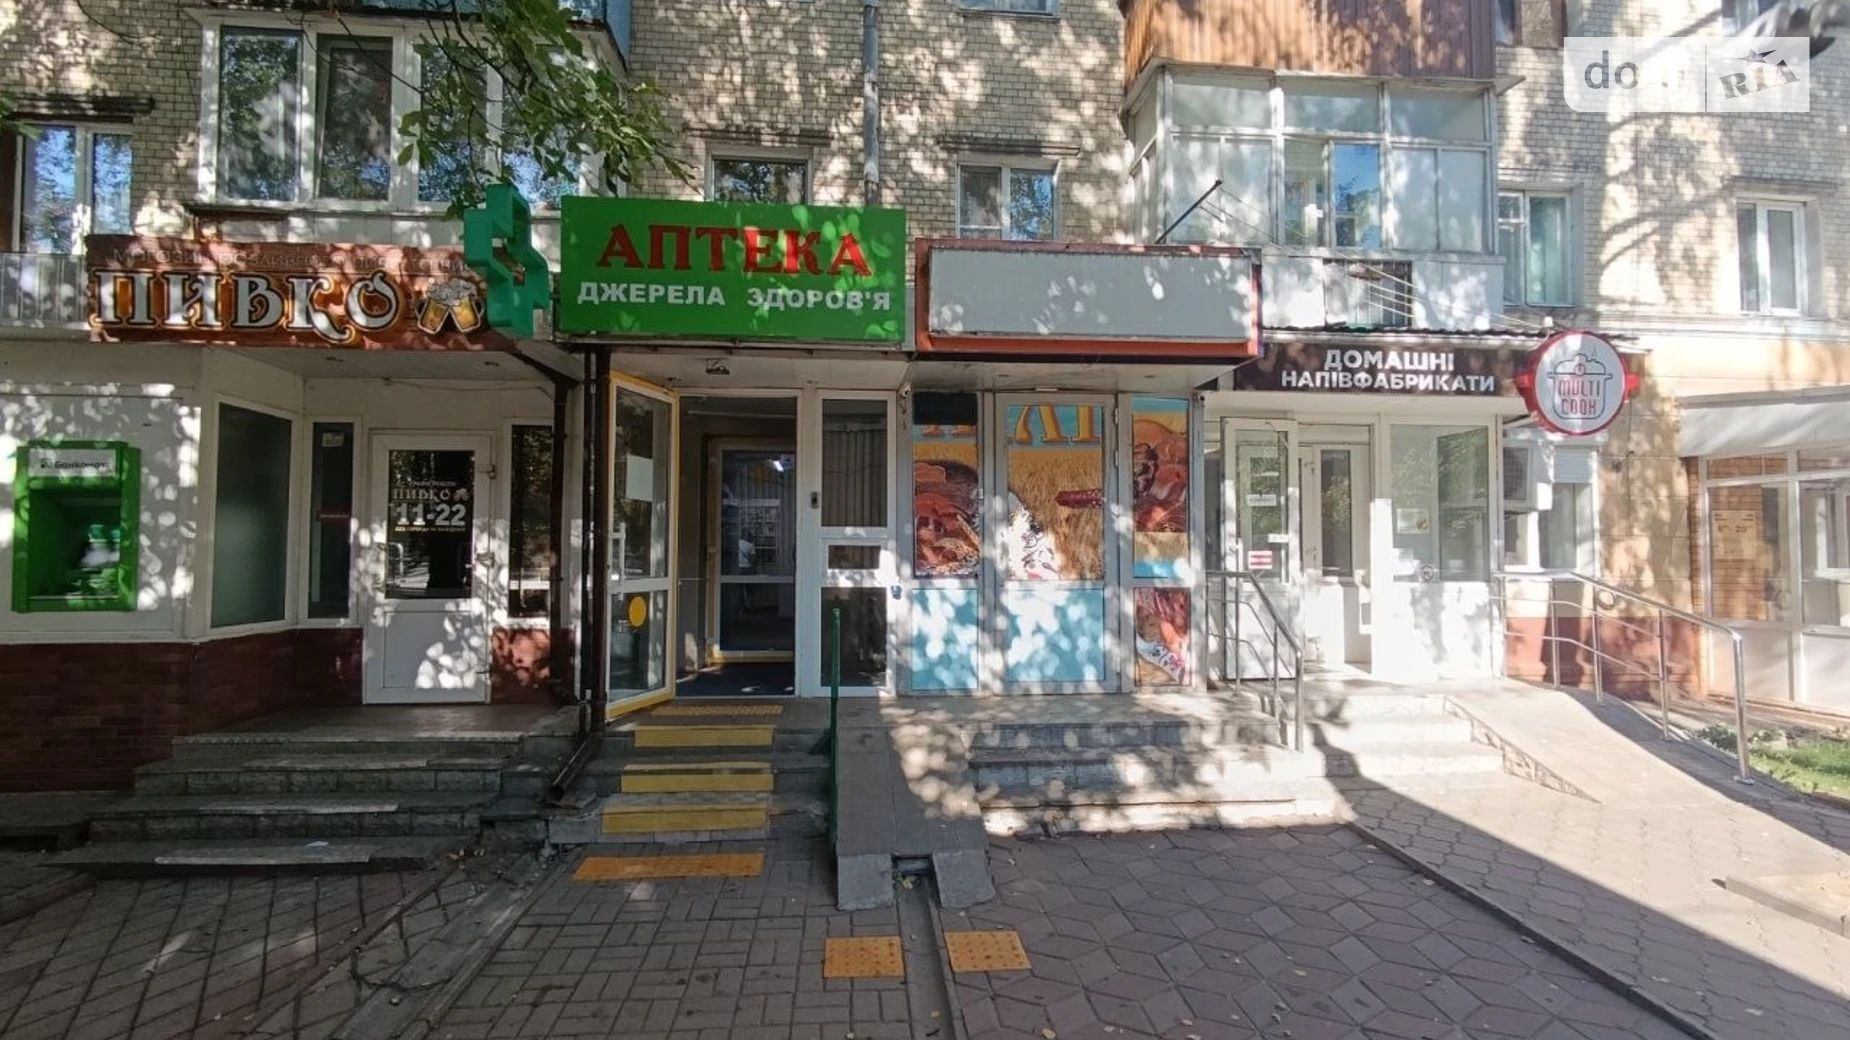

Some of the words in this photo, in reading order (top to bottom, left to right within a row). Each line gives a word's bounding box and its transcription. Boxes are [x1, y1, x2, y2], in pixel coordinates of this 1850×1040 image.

[596, 224, 872, 277] АПТЕКА
[94, 270, 400, 342] ПИВКО
[577, 281, 726, 306] ДЖЕРЕЛА
[747, 287, 890, 311] ЗДОРОВ'Я
[1324, 349, 1454, 371] ДОМАШНІ
[1281, 371, 1495, 392] НАПІВФАБРИКАТИ
[1558, 379, 1600, 397] MULTI
[1561, 398, 1597, 415] COOK
[396, 503, 466, 526] 11-22
